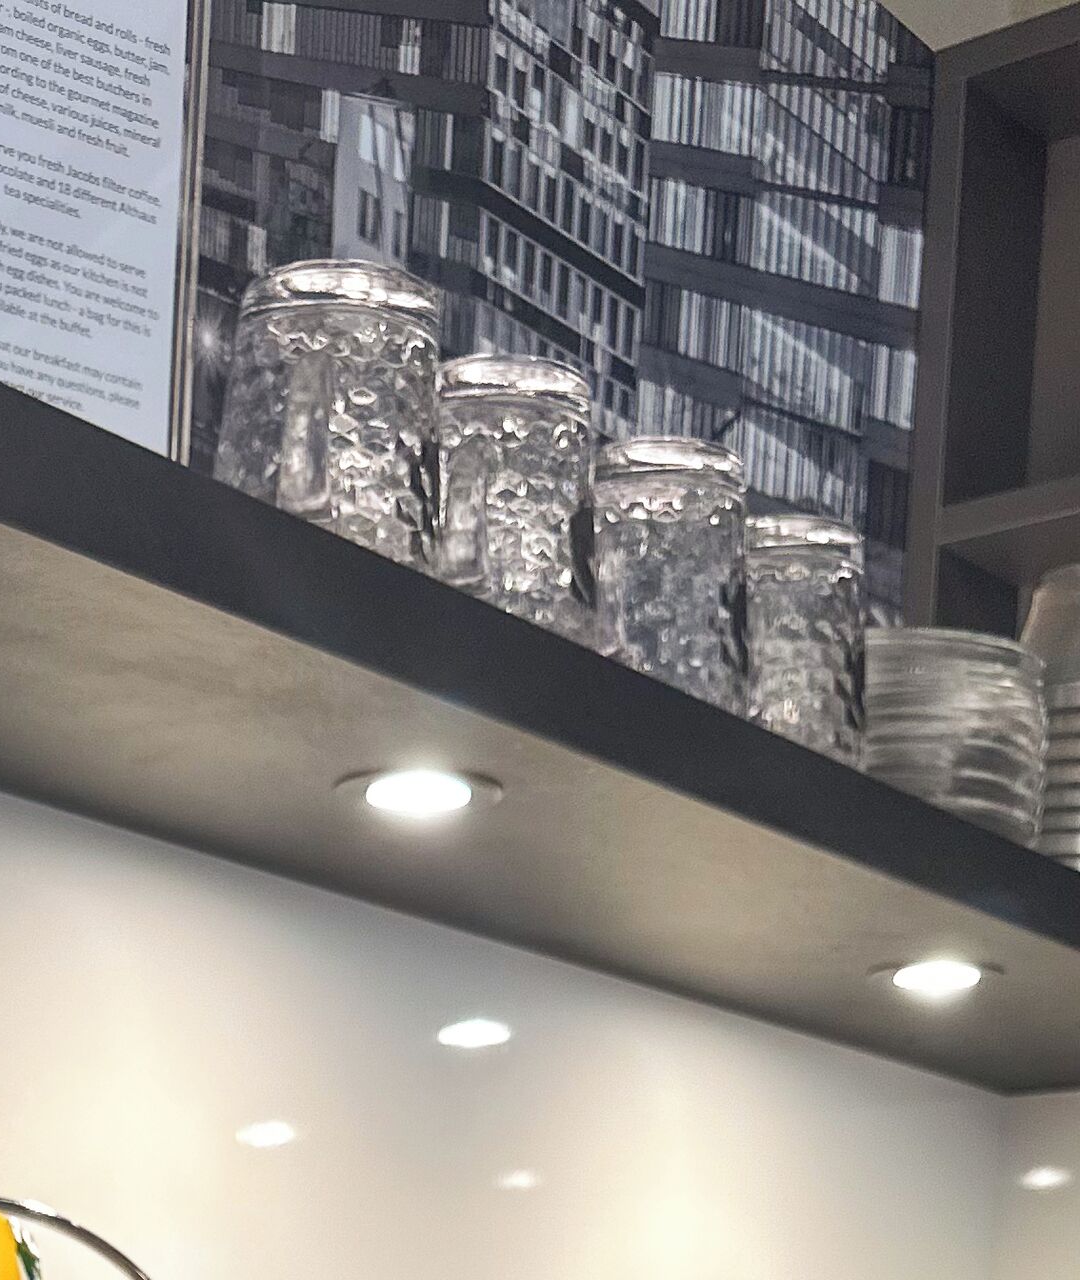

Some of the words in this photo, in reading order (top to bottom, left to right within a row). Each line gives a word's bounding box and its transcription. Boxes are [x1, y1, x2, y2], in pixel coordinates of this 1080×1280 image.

[14, 6, 45, 28] boiled
[47, 22, 84, 42] organic
[51, 3, 61, 15] of
[64, 5, 92, 26] bread
[95, 20, 113, 33] and
[115, 27, 137, 42] rolls
[145, 35, 170, 54] fresh
[16, 29, 52, 53] cheese,
[124, 66, 150, 86] fresh
[19, 52, 38, 66] one
[41, 58, 51, 70] of
[53, 61, 69, 77] the
[72, 67, 93, 85] best
[96, 75, 140, 102] butchers
[142, 92, 151, 106] in
[11, 86, 49, 111] cheese,
[52, 102, 88, 122] various
[123, 127, 161, 147] mineral
[36, 75, 46, 88] to
[49, 79, 65, 95] the
[67, 88, 110, 110] gourmet
